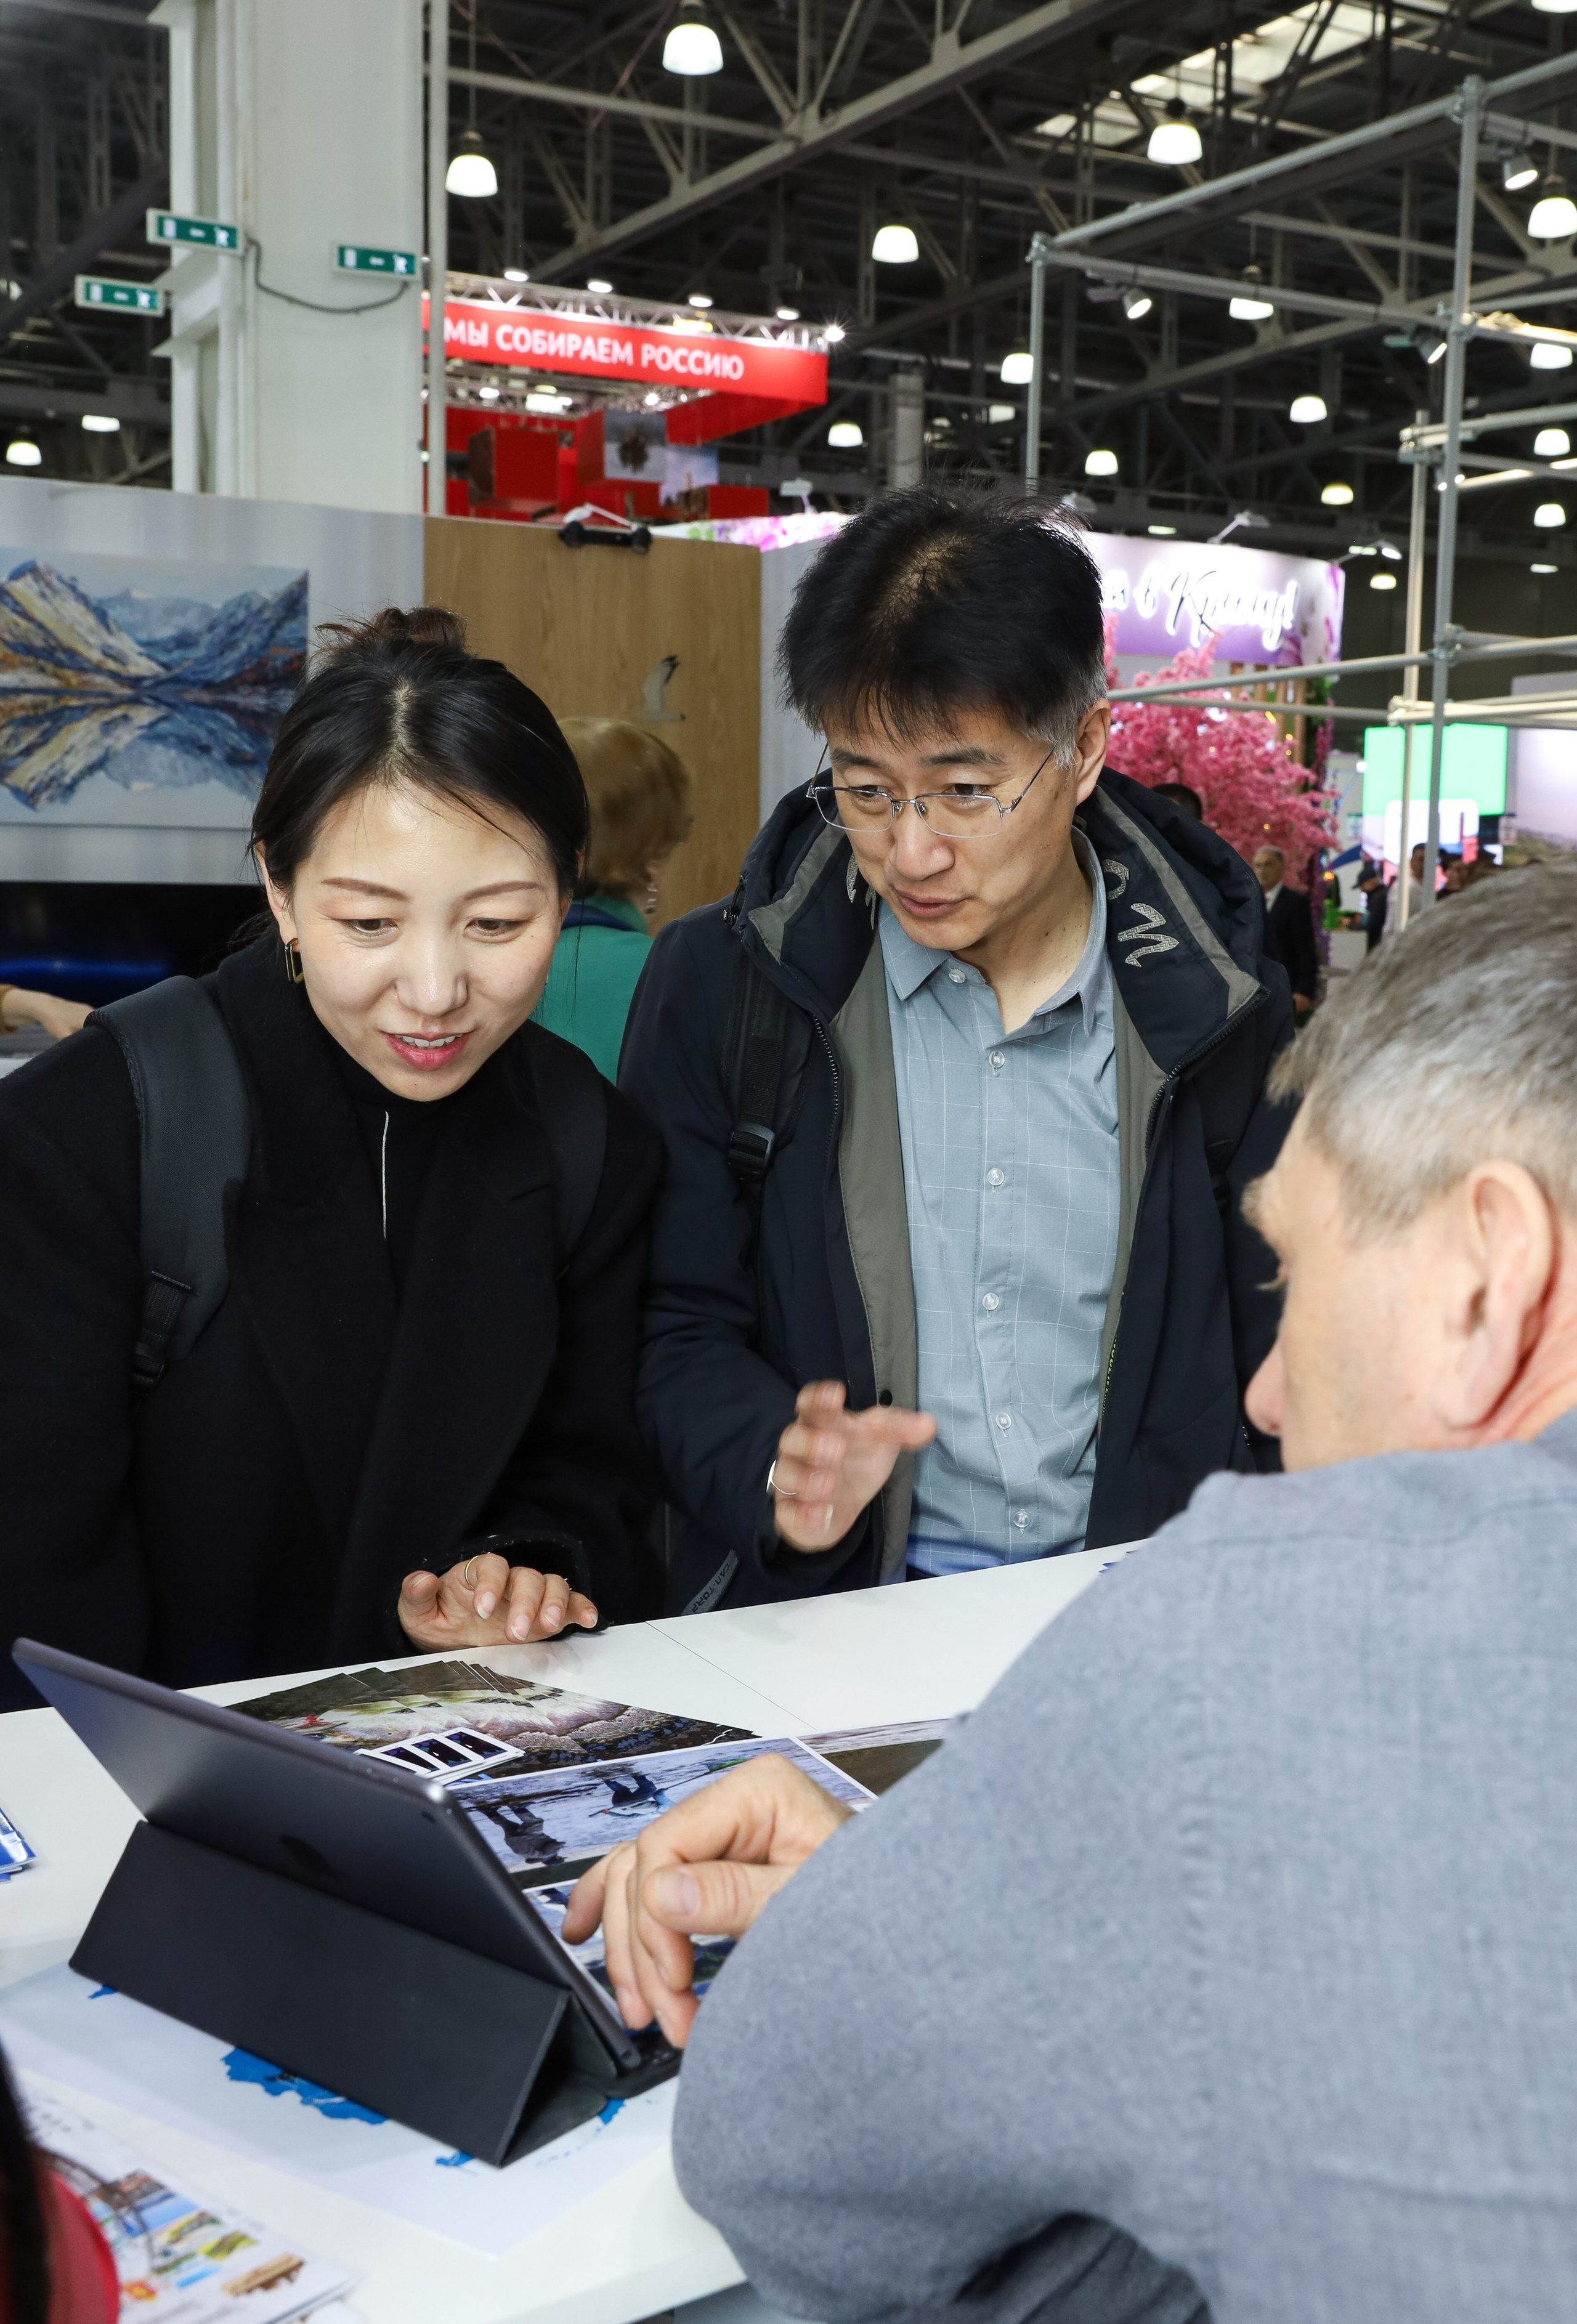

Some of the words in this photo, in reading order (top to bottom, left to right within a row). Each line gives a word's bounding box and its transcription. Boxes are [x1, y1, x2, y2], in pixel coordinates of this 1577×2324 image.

[443, 317, 489, 348] МЫ
[495, 324, 634, 366] СОБИРАЕМ
[641, 342, 744, 381] РОССИЮ
